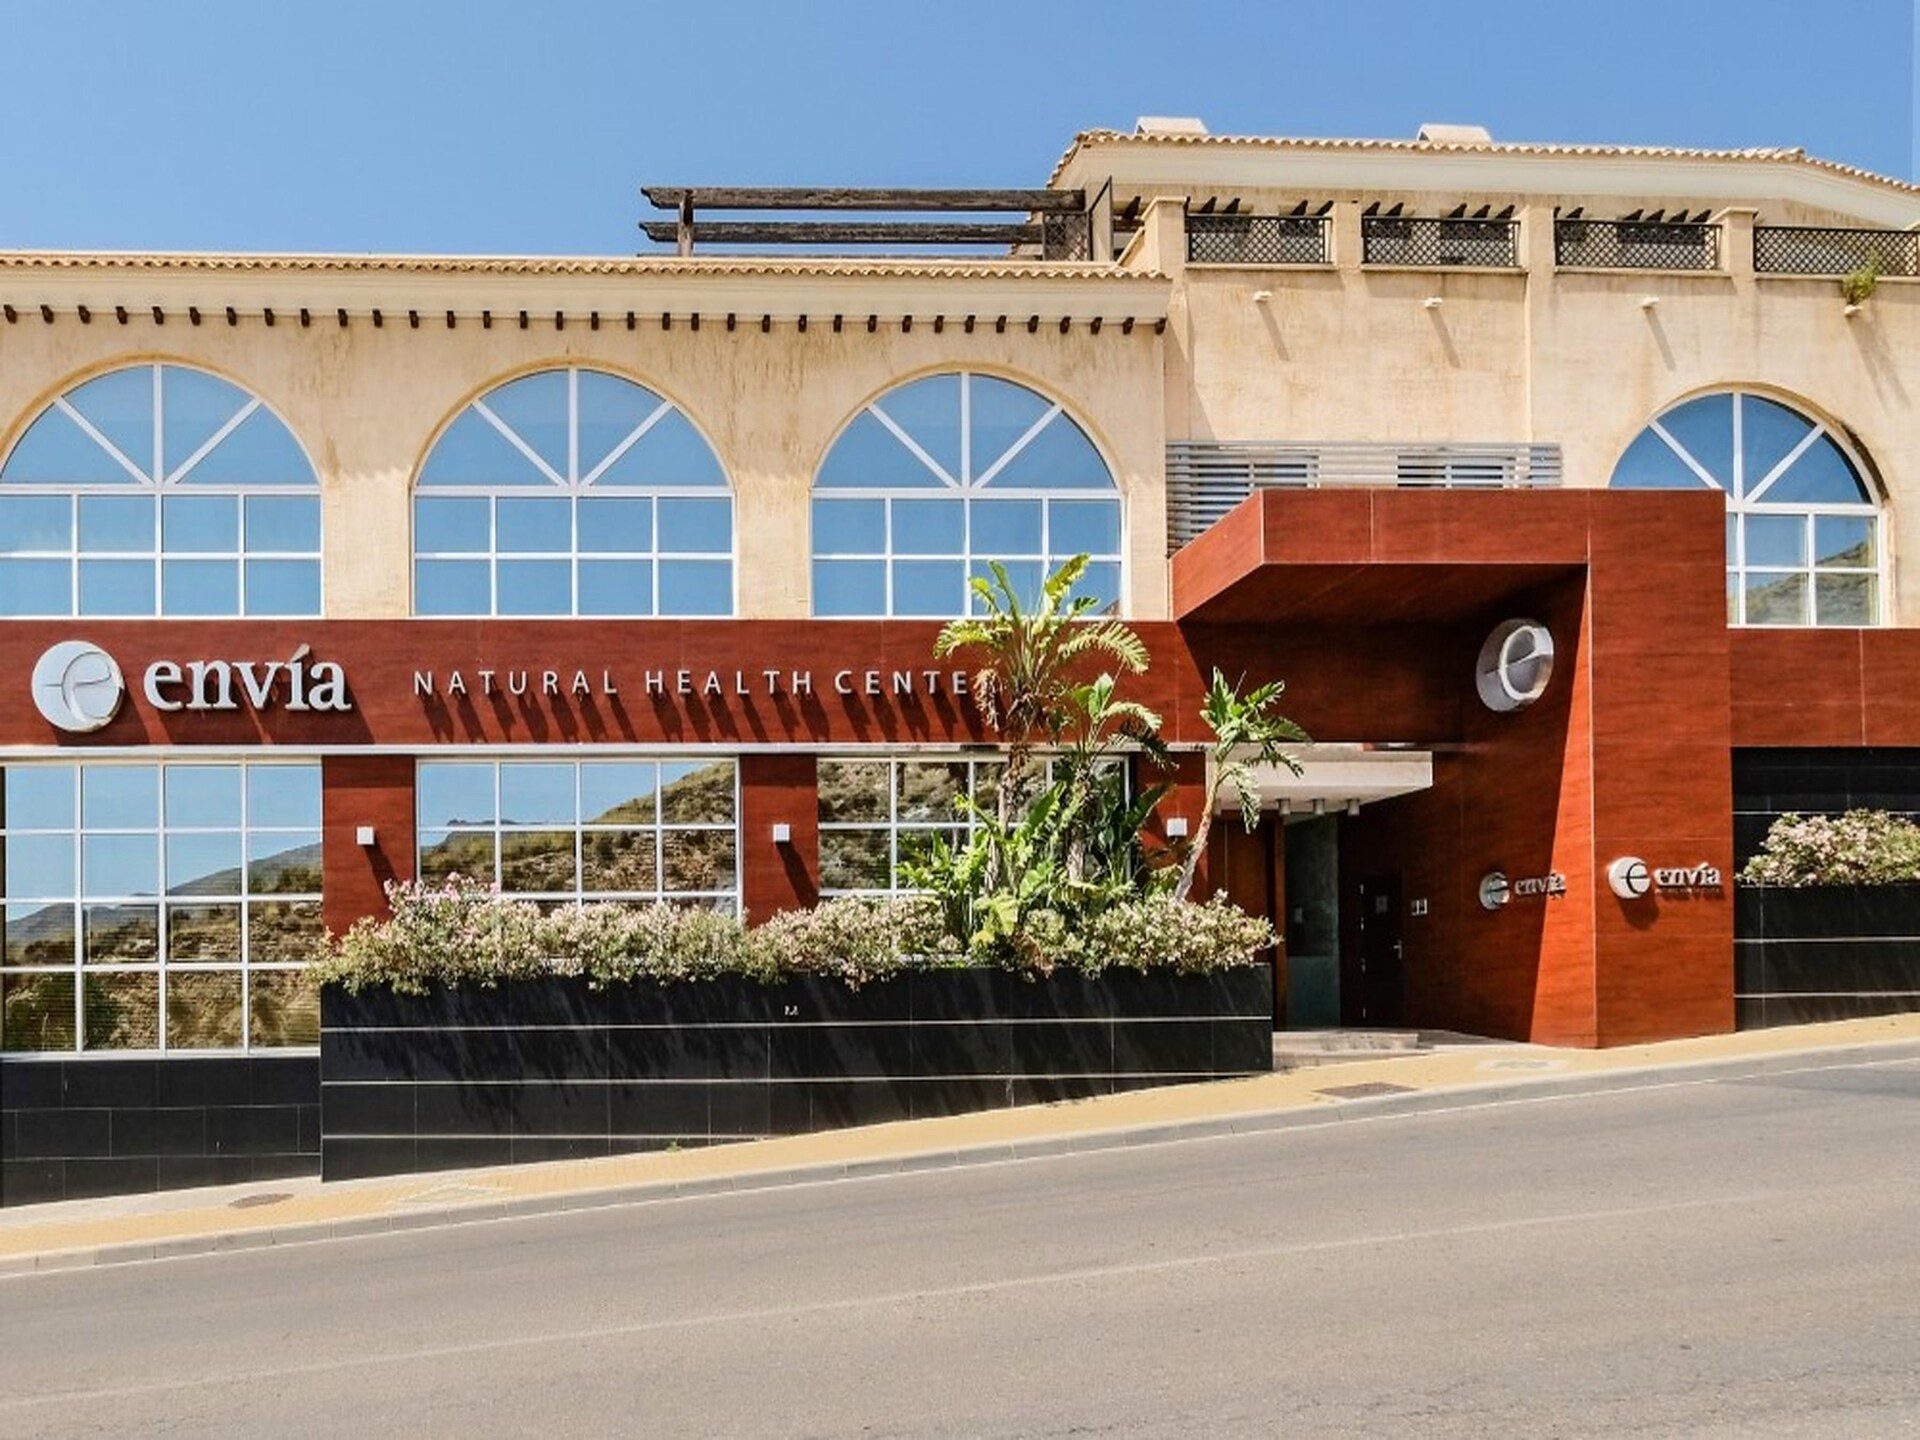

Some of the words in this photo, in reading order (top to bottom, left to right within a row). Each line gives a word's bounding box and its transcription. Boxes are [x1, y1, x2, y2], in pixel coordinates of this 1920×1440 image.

[143, 643, 353, 712] envía
[413, 669, 618, 695] NATURAL
[645, 669, 812, 696] HEALTH
[1654, 861, 1722, 887] envía
